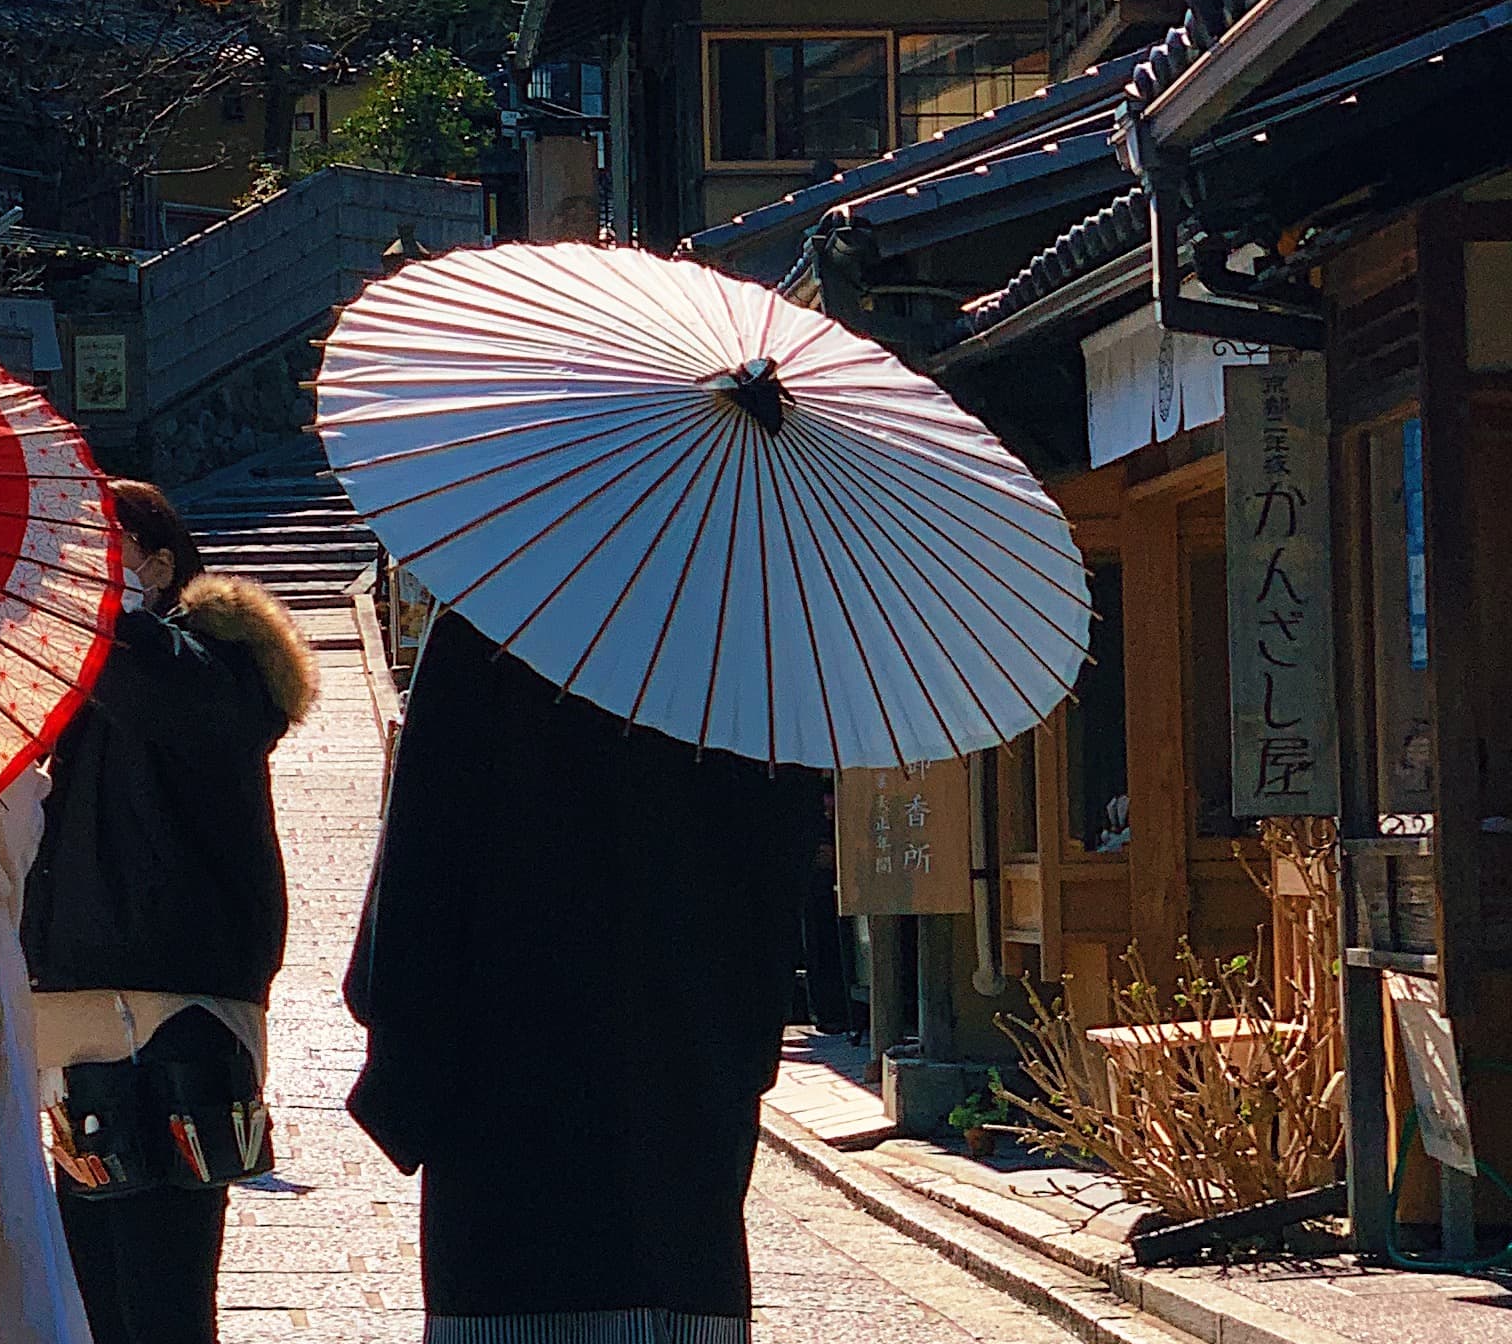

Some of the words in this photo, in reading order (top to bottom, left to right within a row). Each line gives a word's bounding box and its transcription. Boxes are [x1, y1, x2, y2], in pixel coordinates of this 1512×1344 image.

[1251, 482, 1314, 798] かんざし屋
